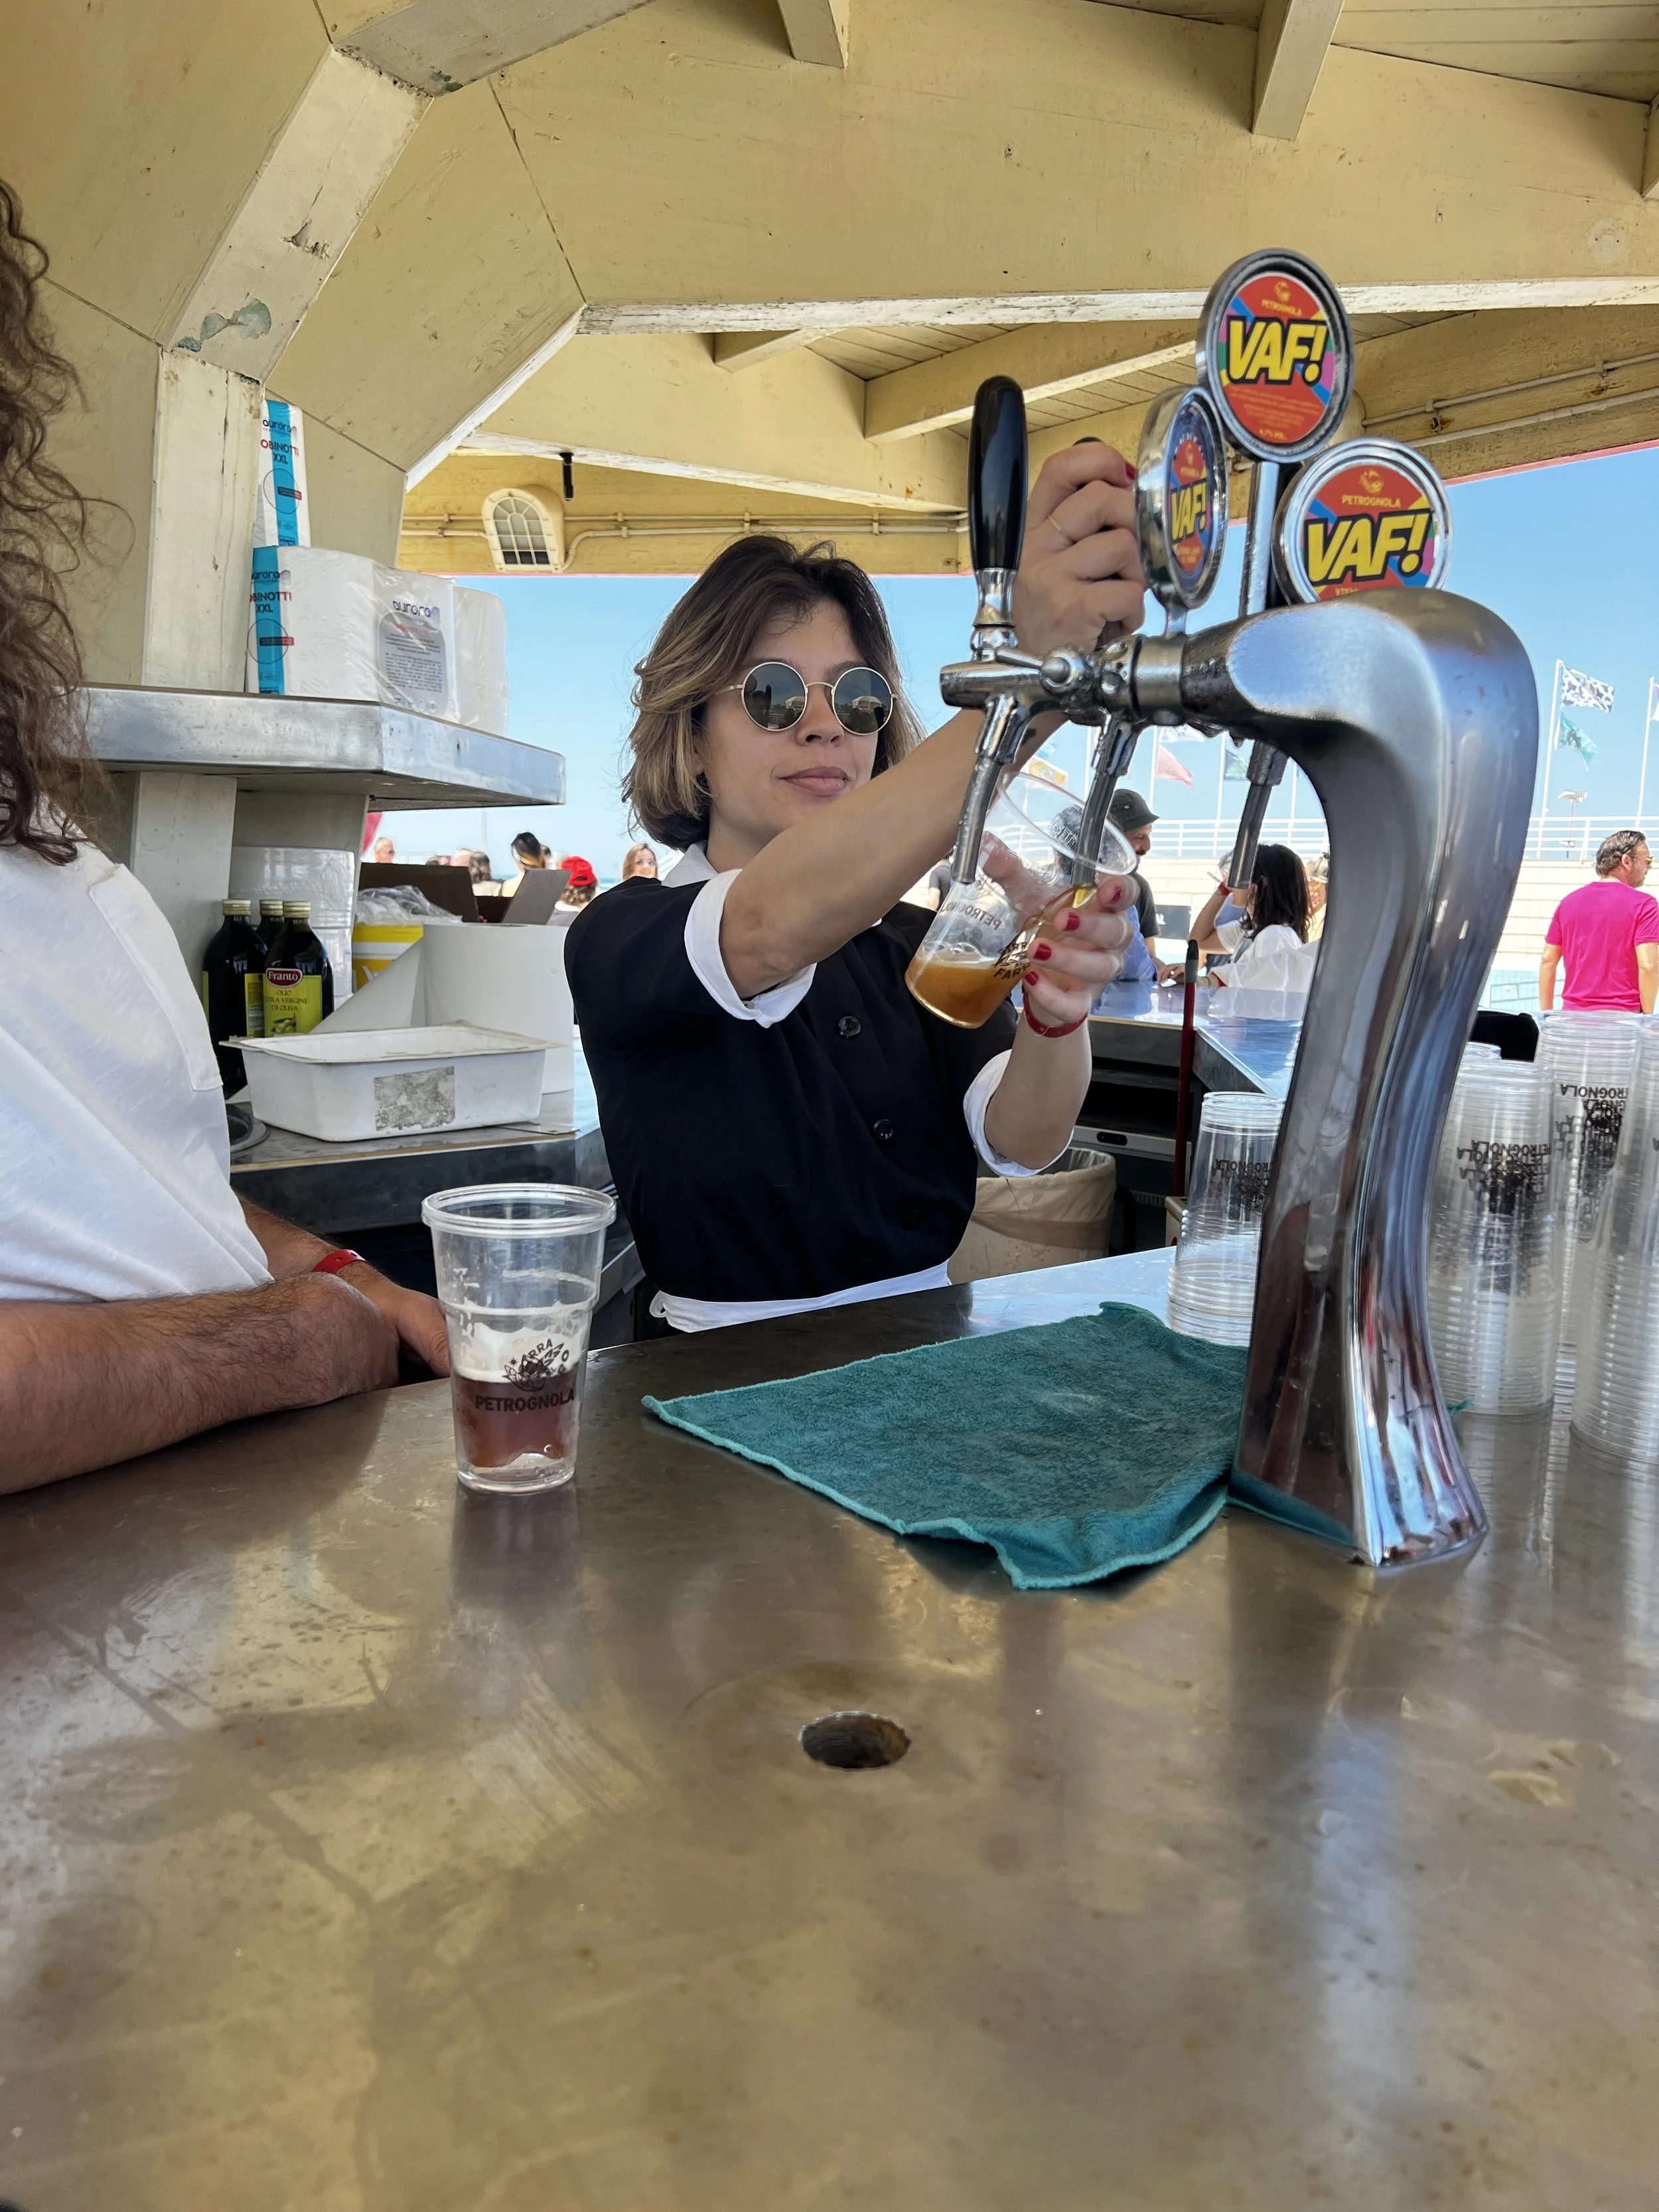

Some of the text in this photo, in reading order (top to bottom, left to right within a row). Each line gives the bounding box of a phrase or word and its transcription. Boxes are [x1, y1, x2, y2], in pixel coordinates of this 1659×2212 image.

[1228, 317, 1328, 387] VAF!
[261, 439, 299, 457] OBINOTTI
[273, 453, 289, 465] XXL
[1171, 478, 1207, 544] VAF!
[1342, 495, 1401, 508] PETROGNOLA
[1304, 509, 1432, 586] VAF!
[475, 1387, 575, 1412] PETROGNOLA
